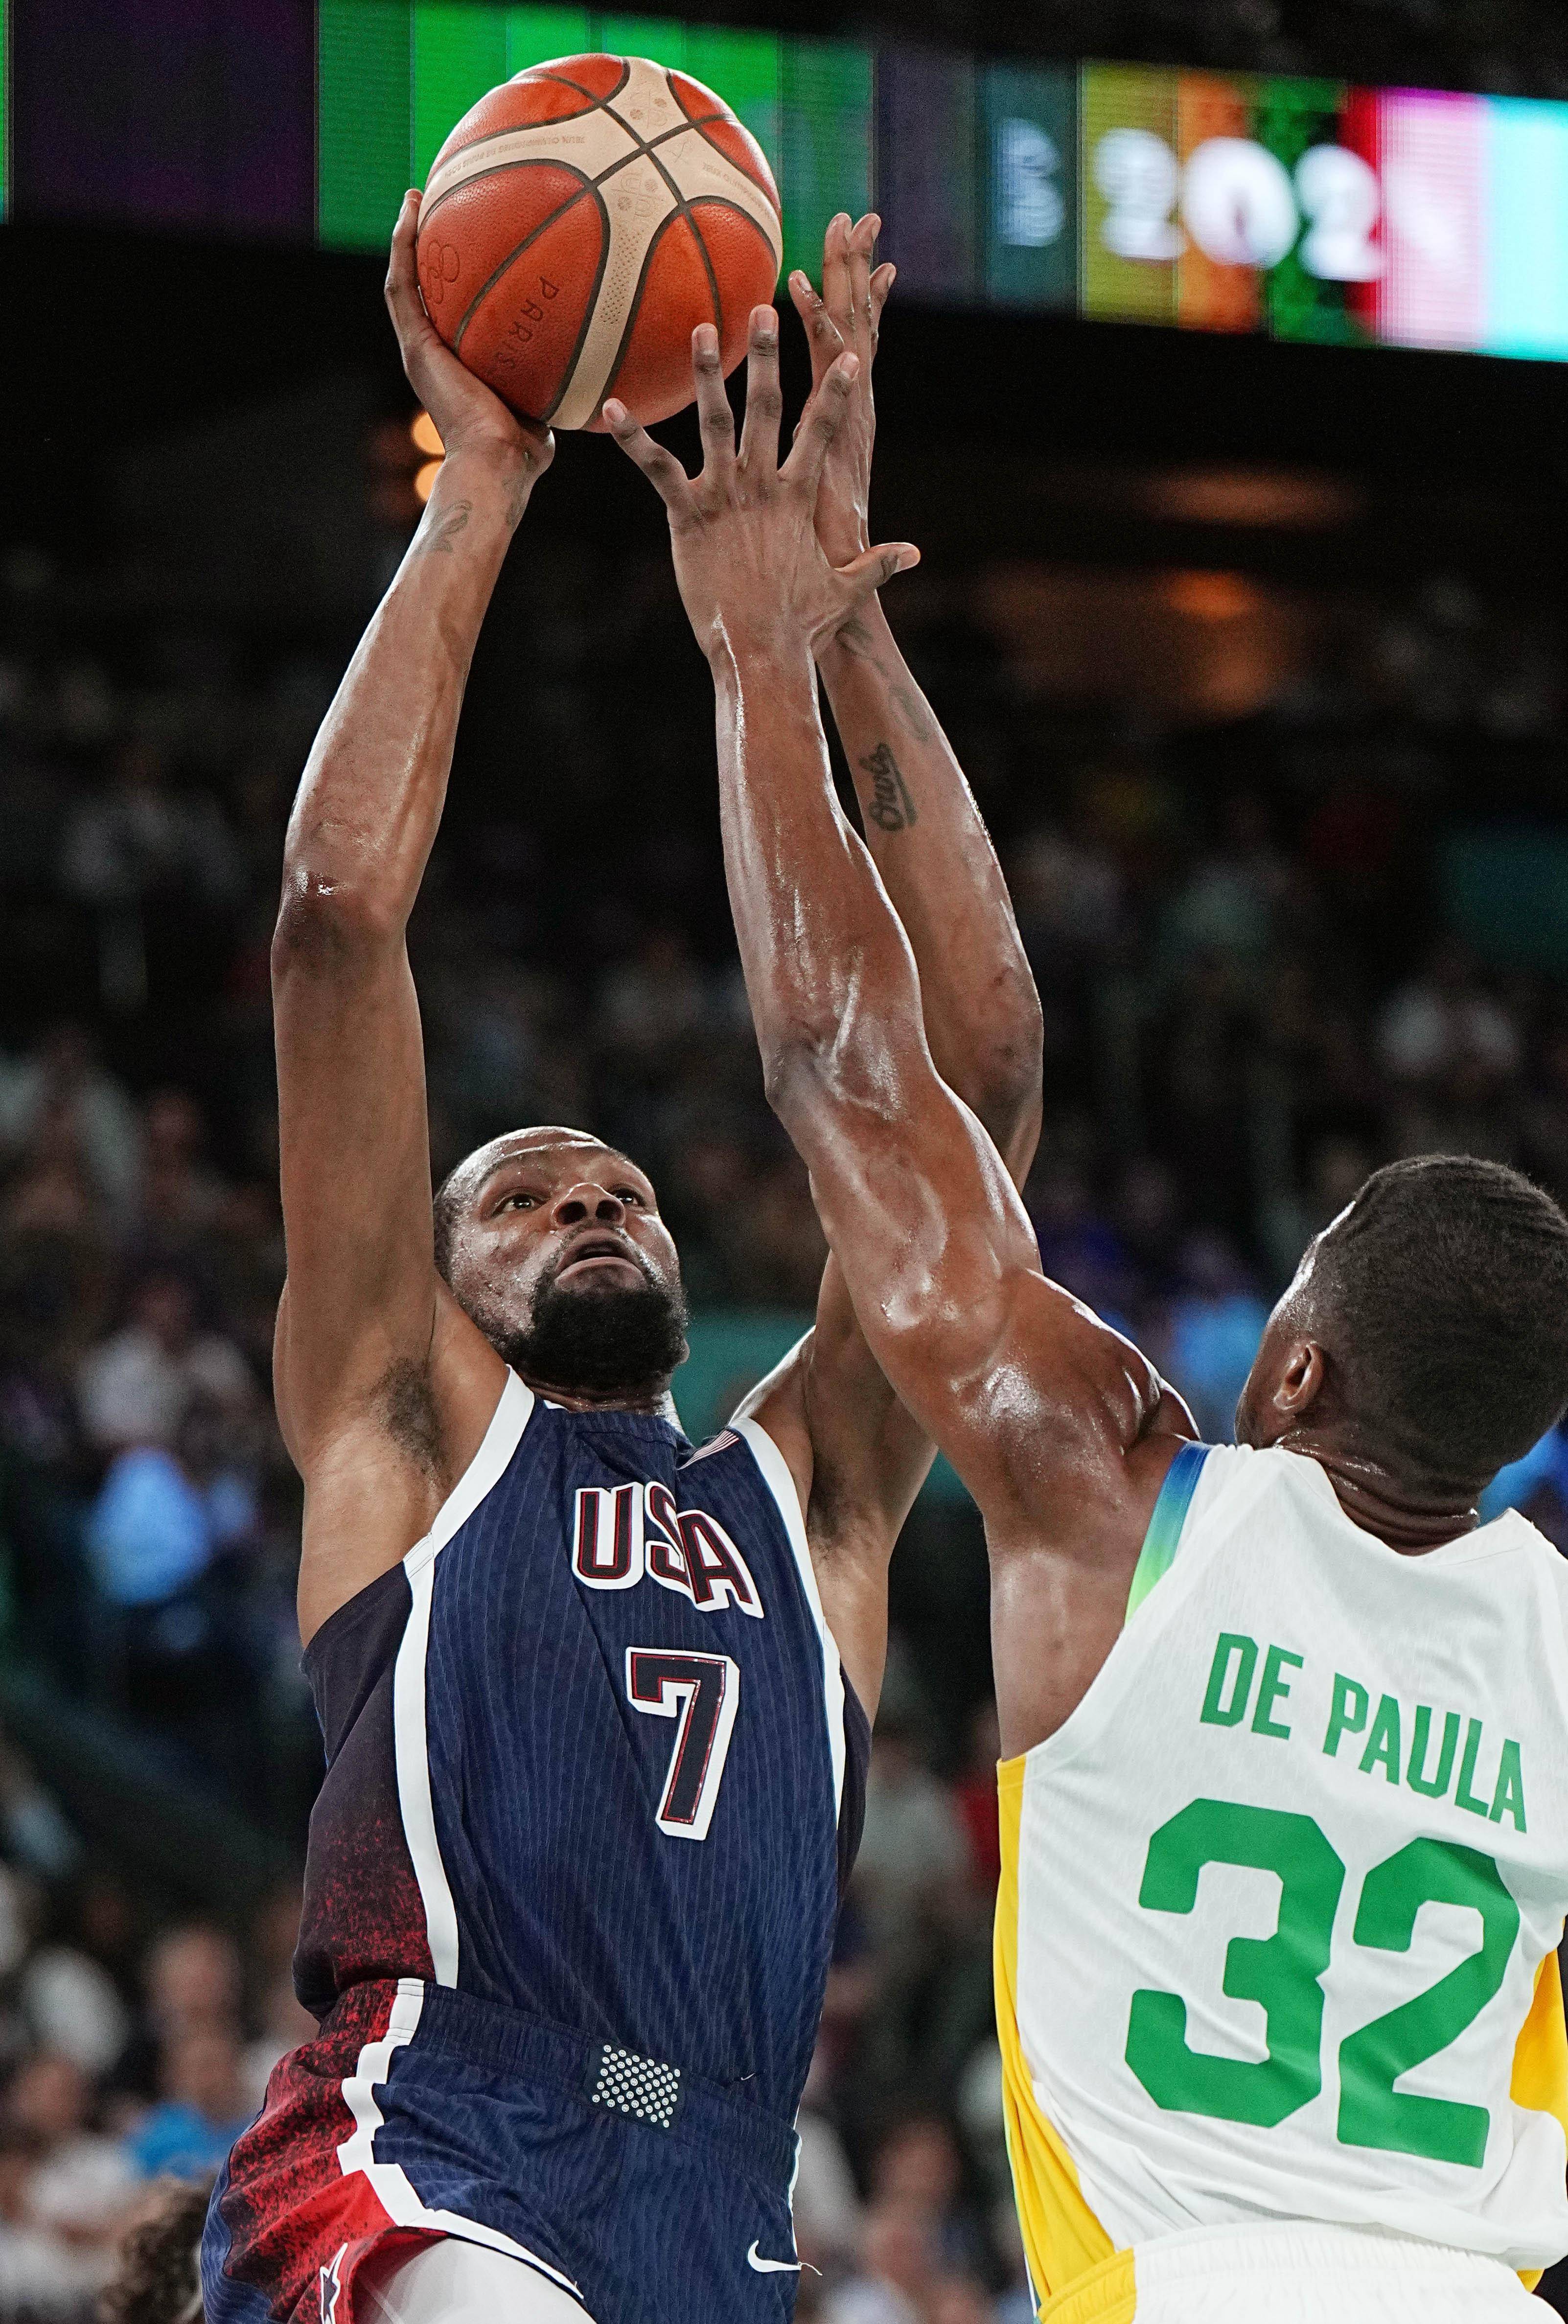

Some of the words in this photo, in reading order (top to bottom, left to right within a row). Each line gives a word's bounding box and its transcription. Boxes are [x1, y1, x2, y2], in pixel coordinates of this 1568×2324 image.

[572, 1481, 764, 1619] USA
[626, 1647, 740, 1841] 7
[1199, 1632, 1304, 1741] DE
[1322, 1672, 1527, 1834] PAULA
[1125, 1797, 1521, 2170] 32
